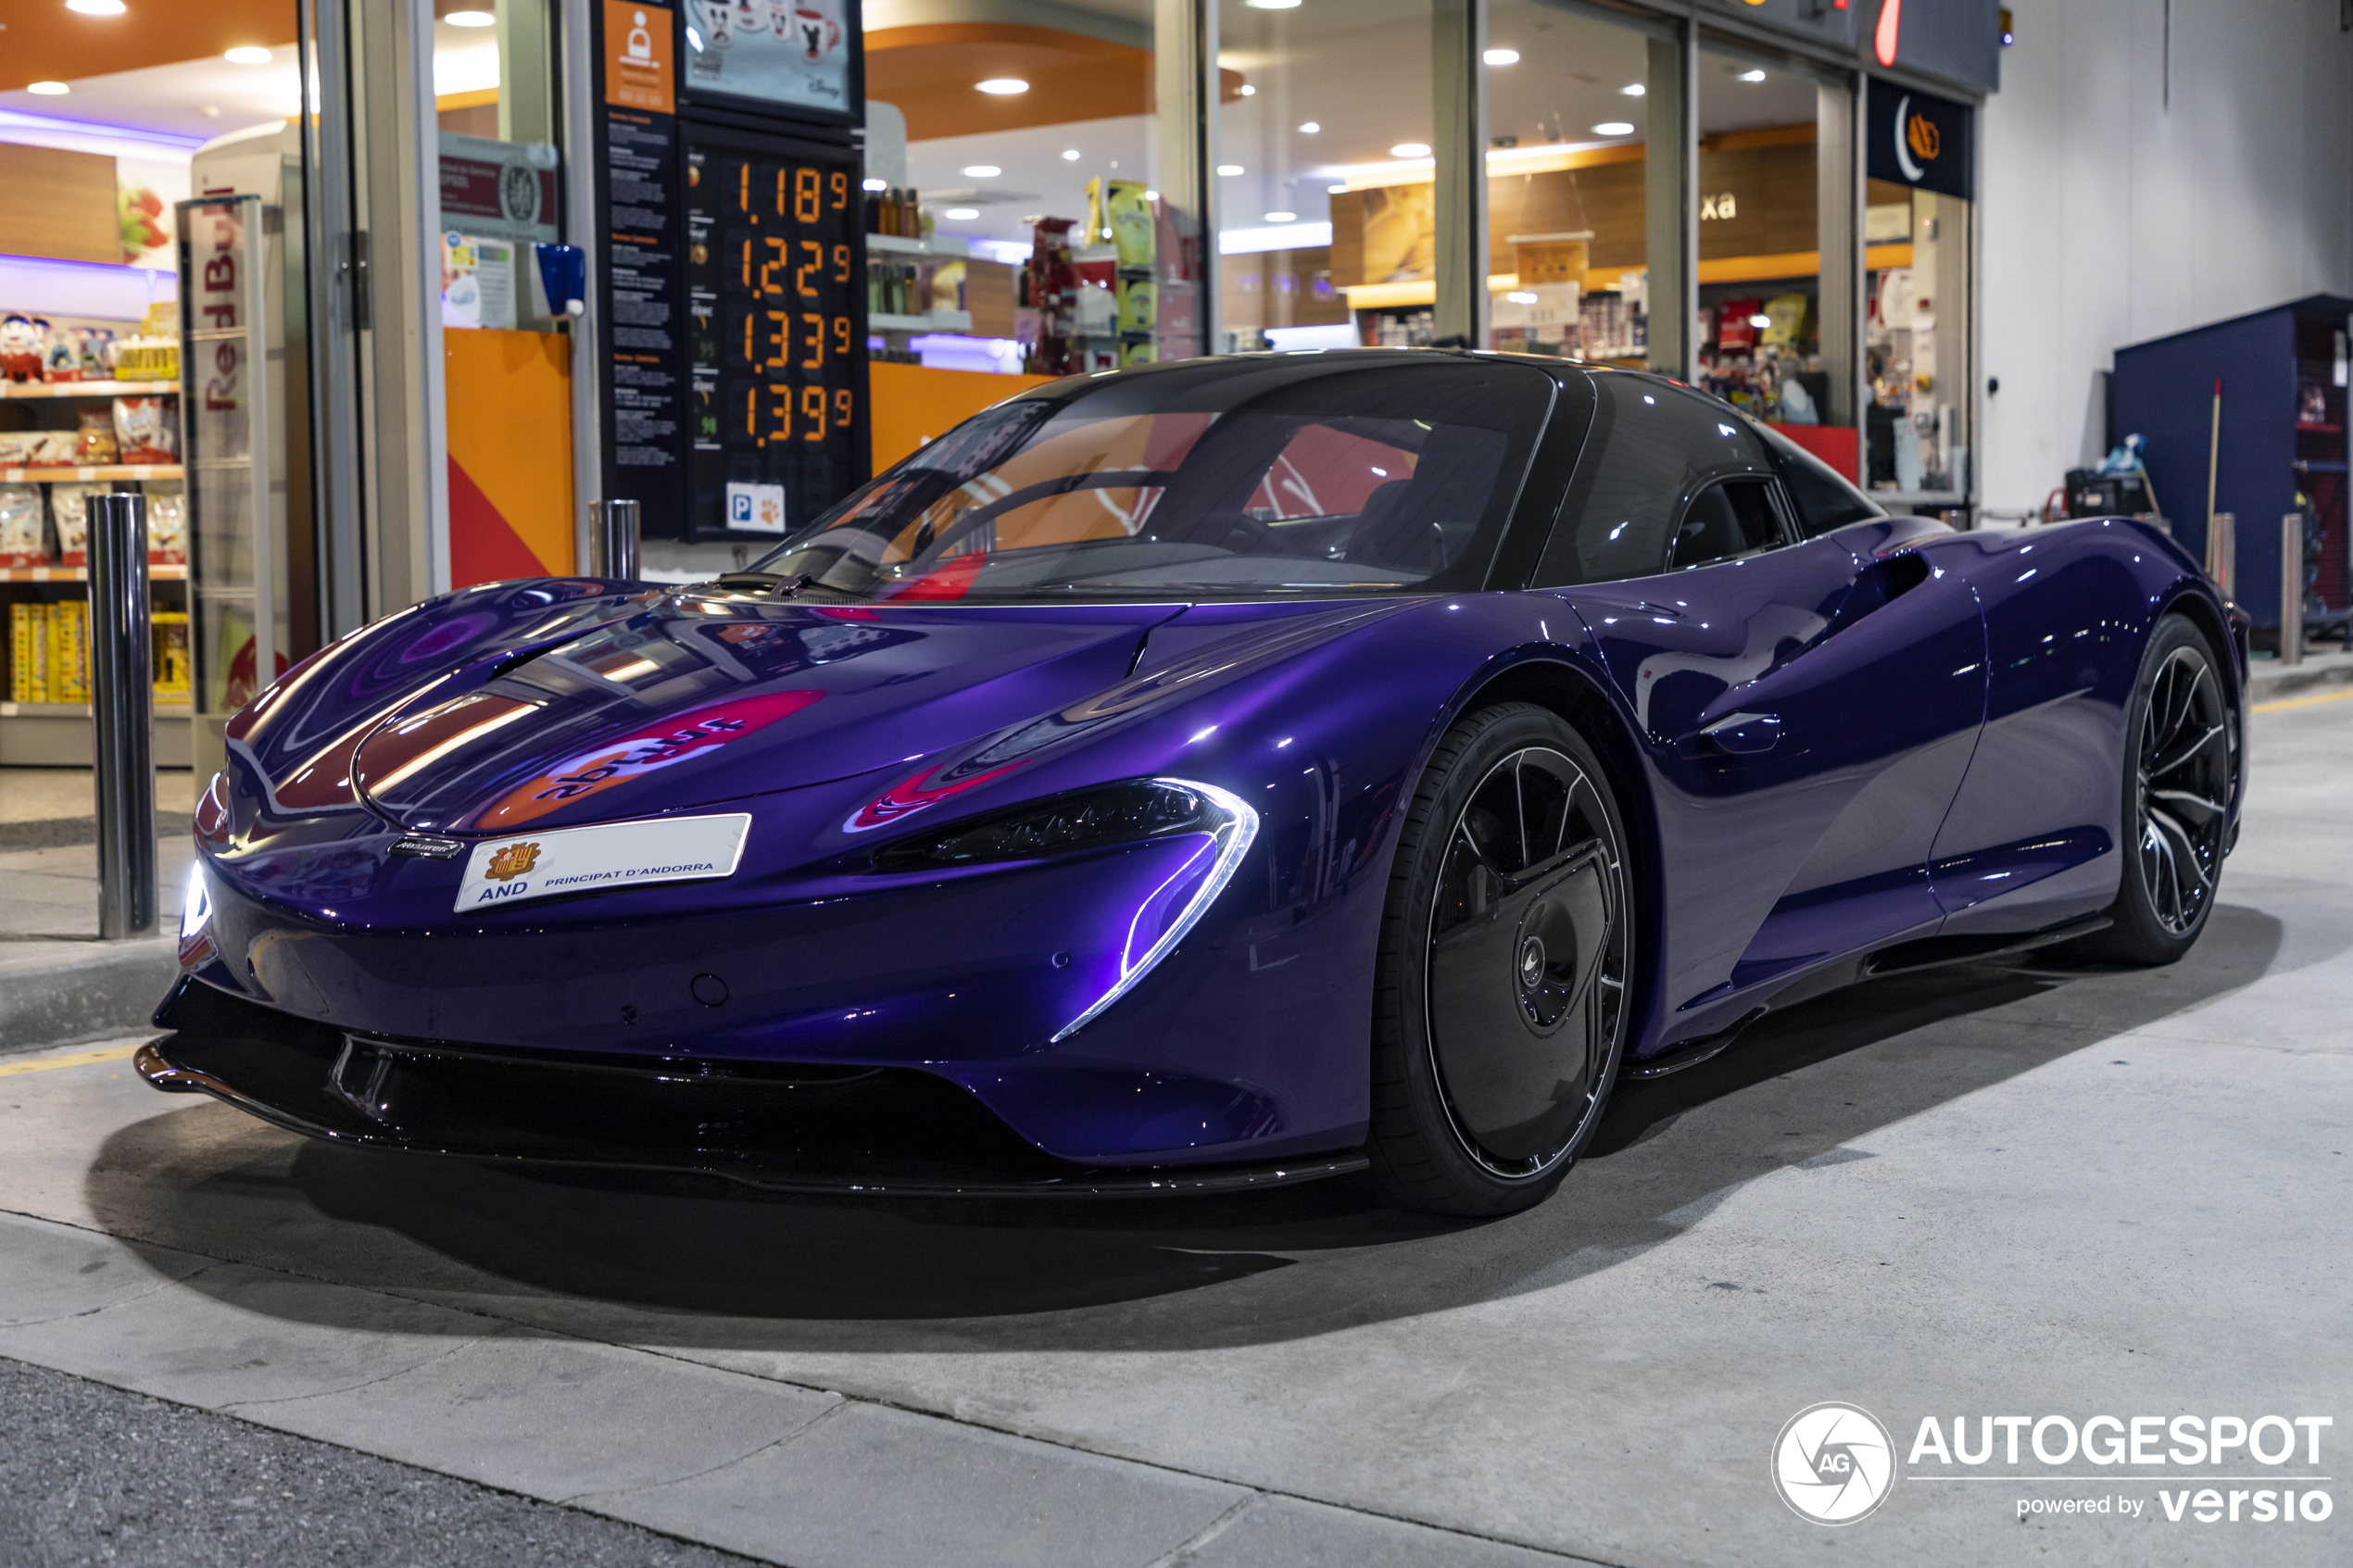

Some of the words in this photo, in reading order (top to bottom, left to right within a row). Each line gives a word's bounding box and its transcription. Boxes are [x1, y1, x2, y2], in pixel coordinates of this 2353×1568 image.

[203, 304, 237, 411] Red
[736, 497, 749, 519] P
[545, 869, 623, 887] PRINCIPAT
[625, 862, 713, 877] D'ANDORRA
[477, 881, 528, 902] AND
